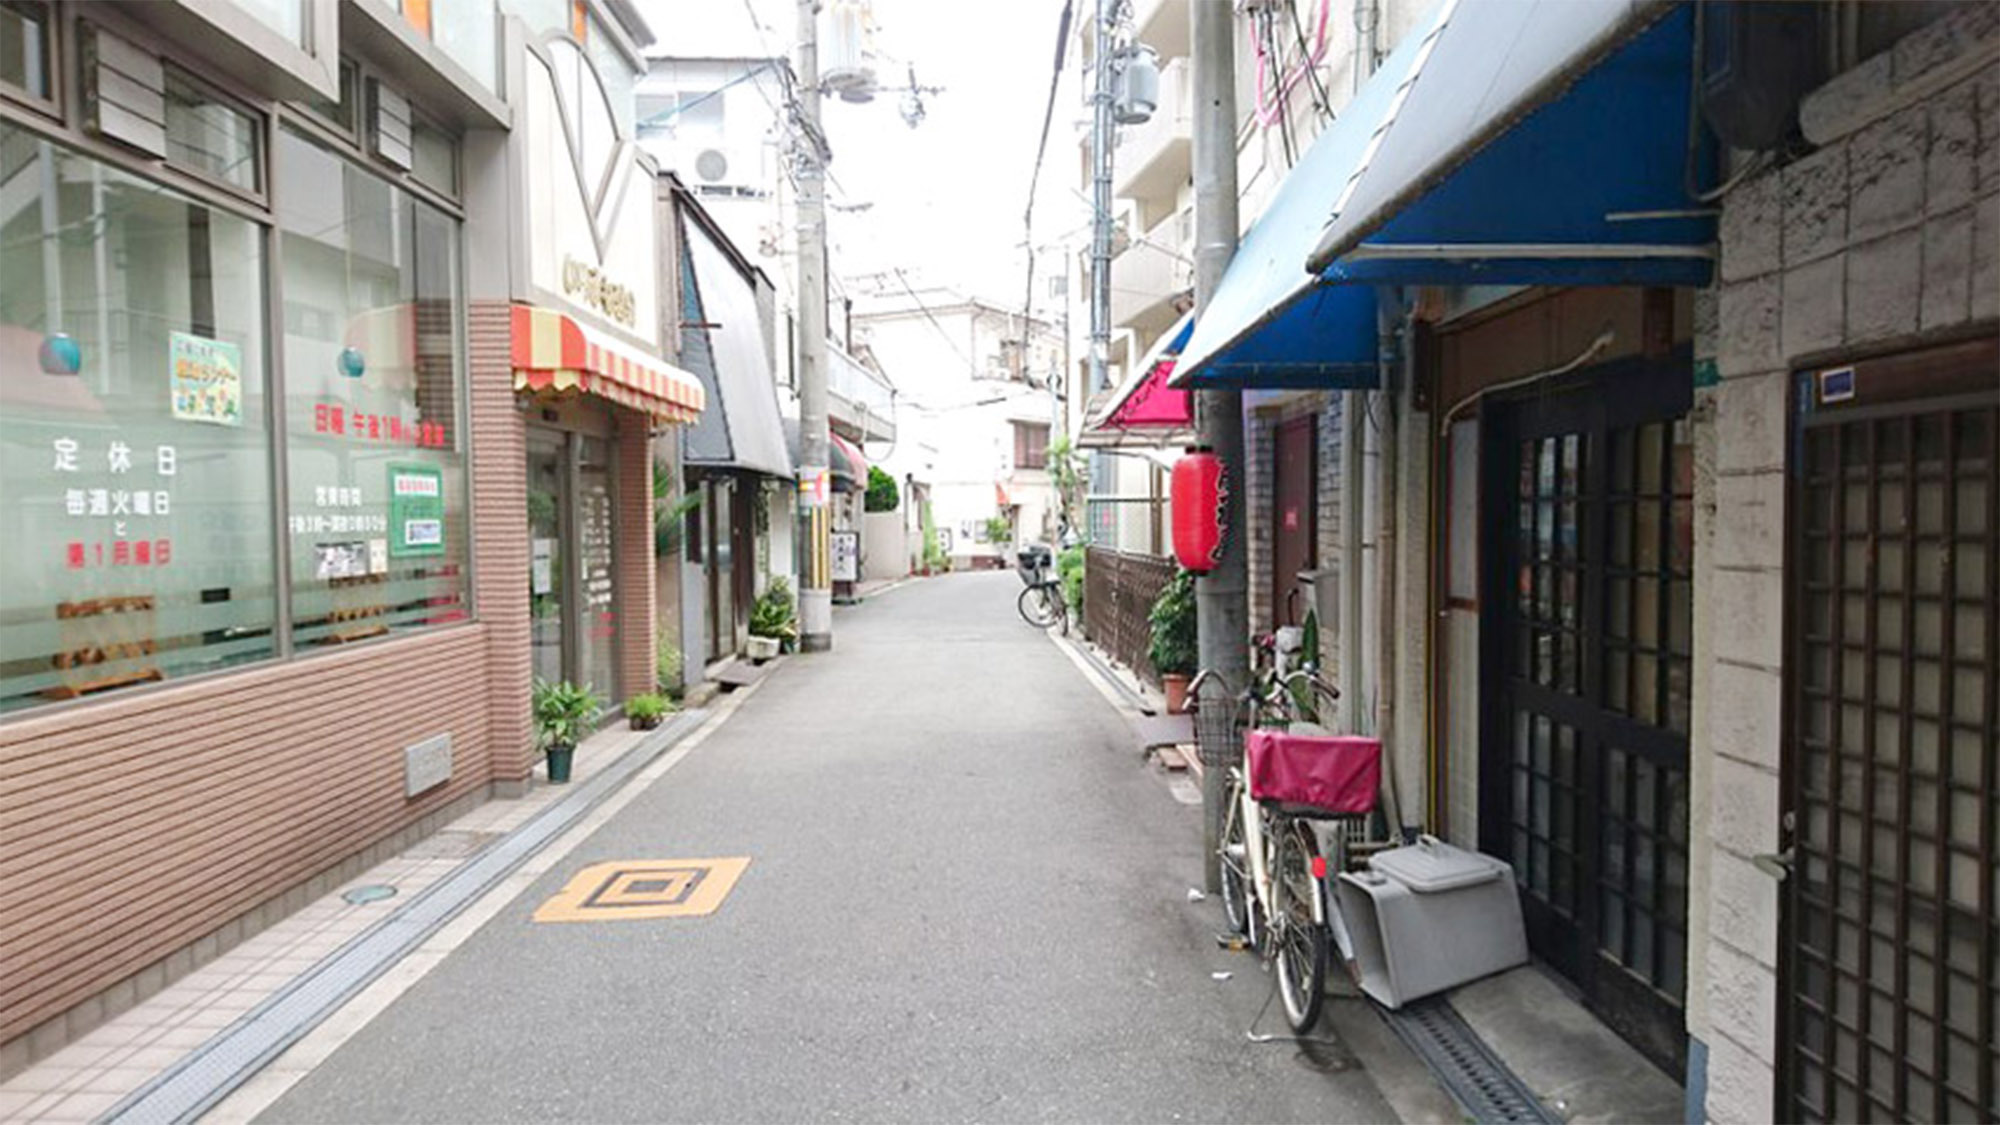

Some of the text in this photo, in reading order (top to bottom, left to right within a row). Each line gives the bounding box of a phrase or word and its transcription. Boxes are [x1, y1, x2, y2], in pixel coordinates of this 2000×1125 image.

[54, 436, 177, 475] 定休日
[66, 488, 170, 516] 毎週火曜日
